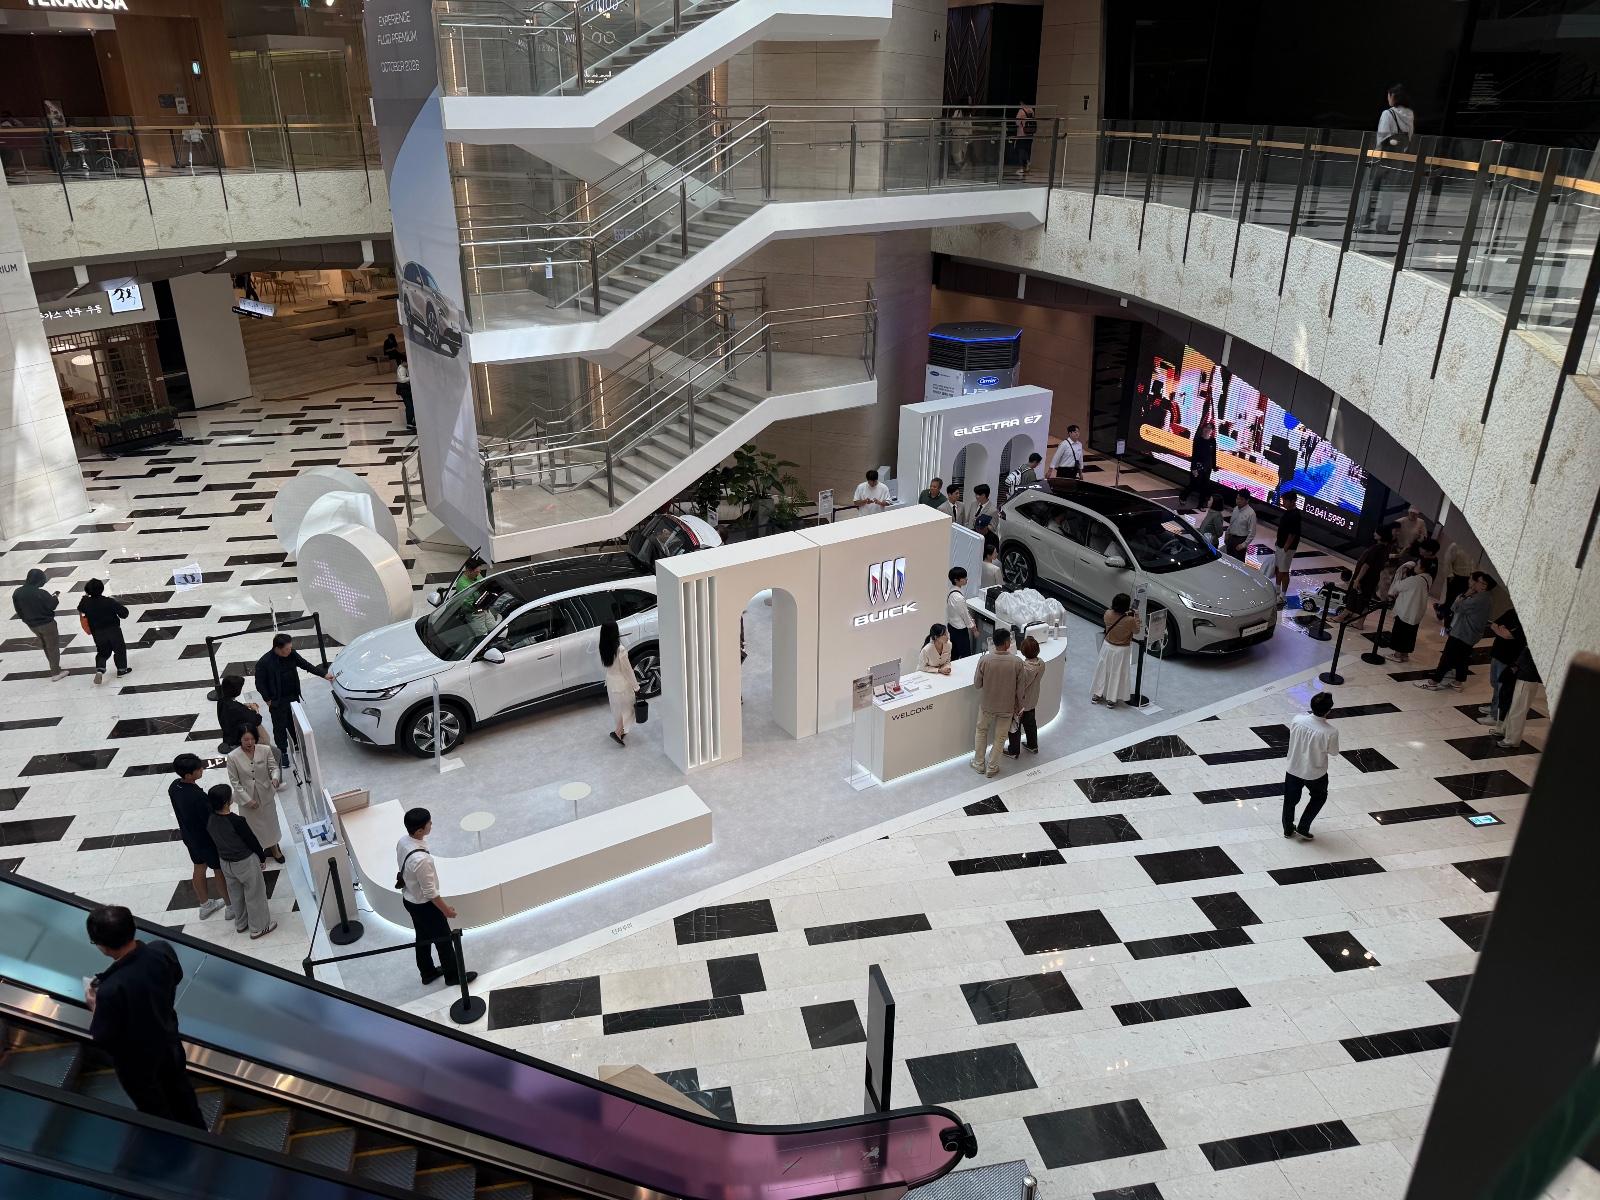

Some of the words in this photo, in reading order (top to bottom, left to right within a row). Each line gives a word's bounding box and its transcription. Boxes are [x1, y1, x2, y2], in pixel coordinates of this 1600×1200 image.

[953, 418, 1020, 437] ELECTRA
[1023, 414, 1043, 425] E7
[853, 601, 919, 627] BUICK
[891, 703, 934, 721] WELCOME
